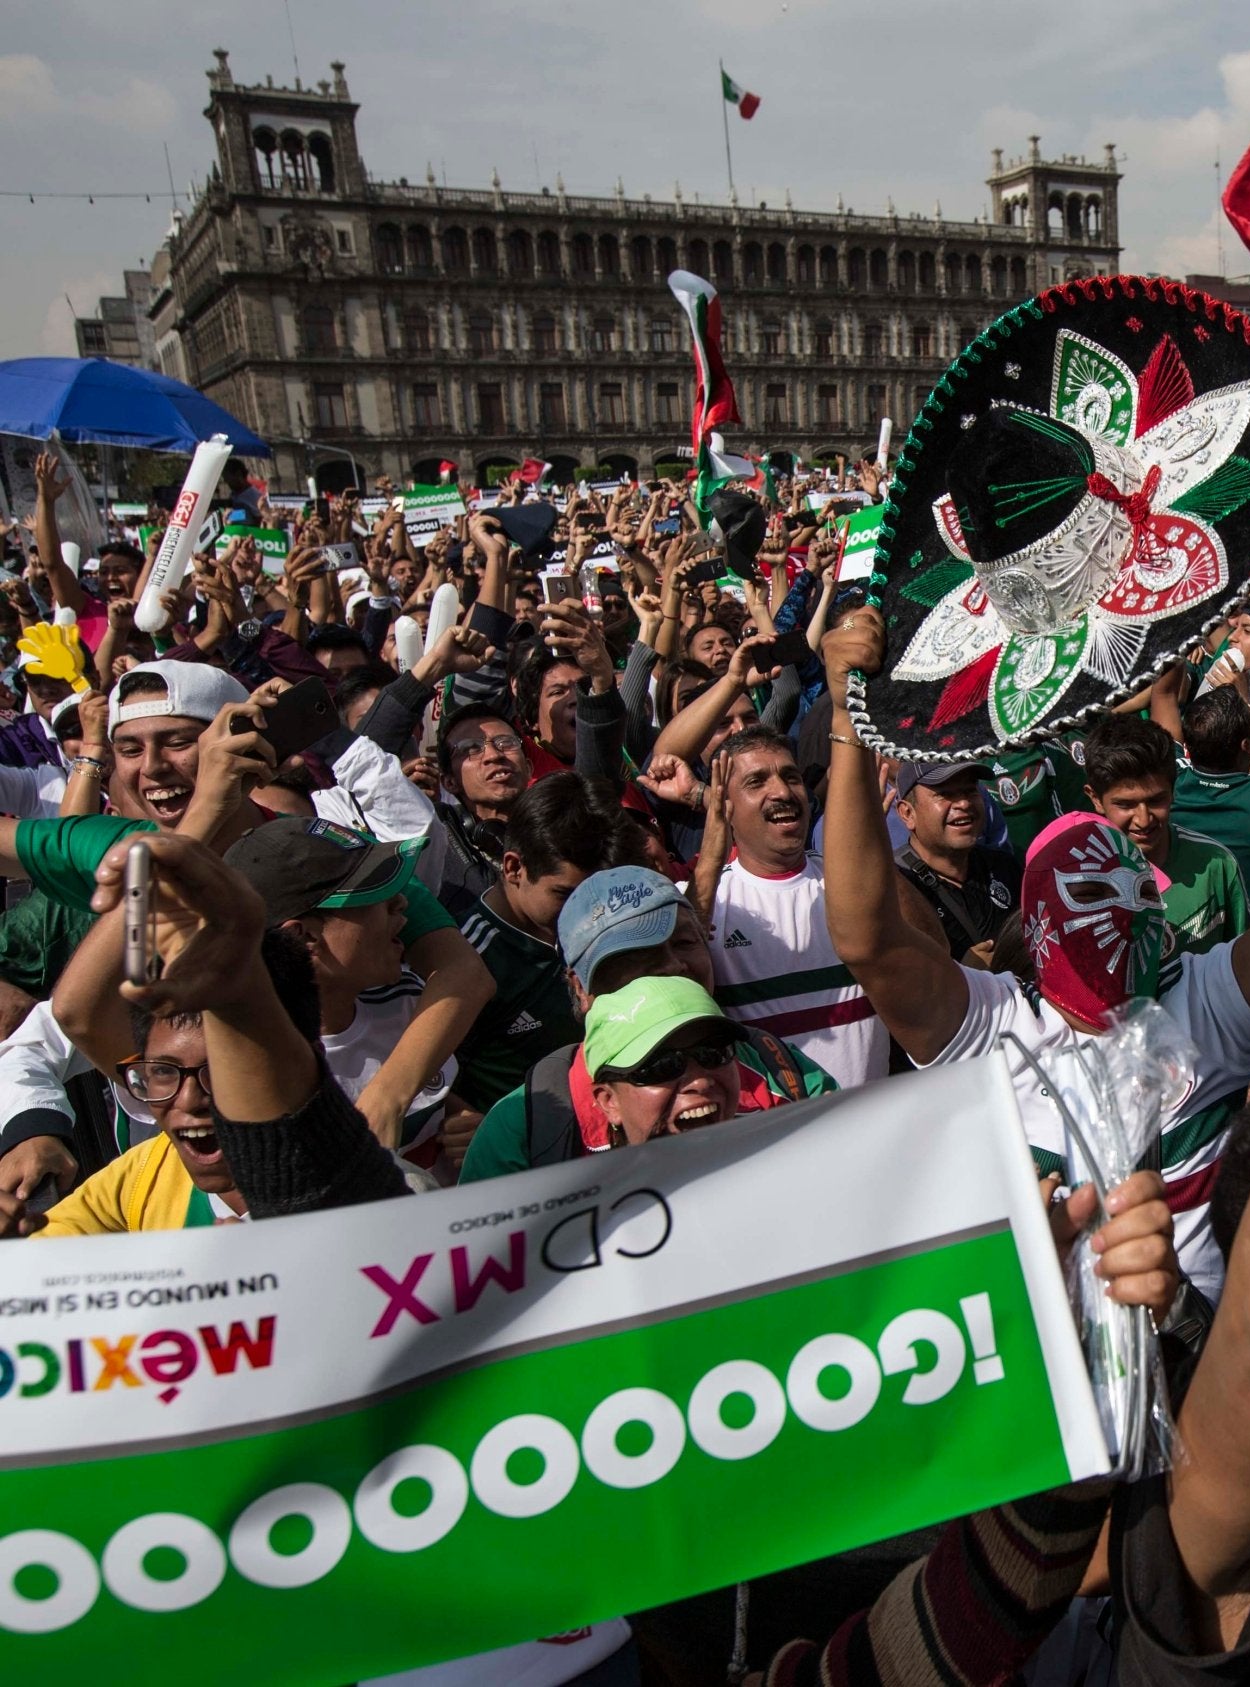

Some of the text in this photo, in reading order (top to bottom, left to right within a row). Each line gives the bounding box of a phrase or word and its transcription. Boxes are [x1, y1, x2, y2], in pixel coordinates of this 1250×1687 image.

[507, 1020, 543, 1035] adidas
[518, 1202, 540, 1218] DE
[544, 1185, 602, 1212] CIUDAD
[360, 1188, 672, 1339] CDMX
[127, 1280, 229, 1308] MUNDO
[237, 1273, 279, 1296] UN
[86, 1293, 119, 1312] EN
